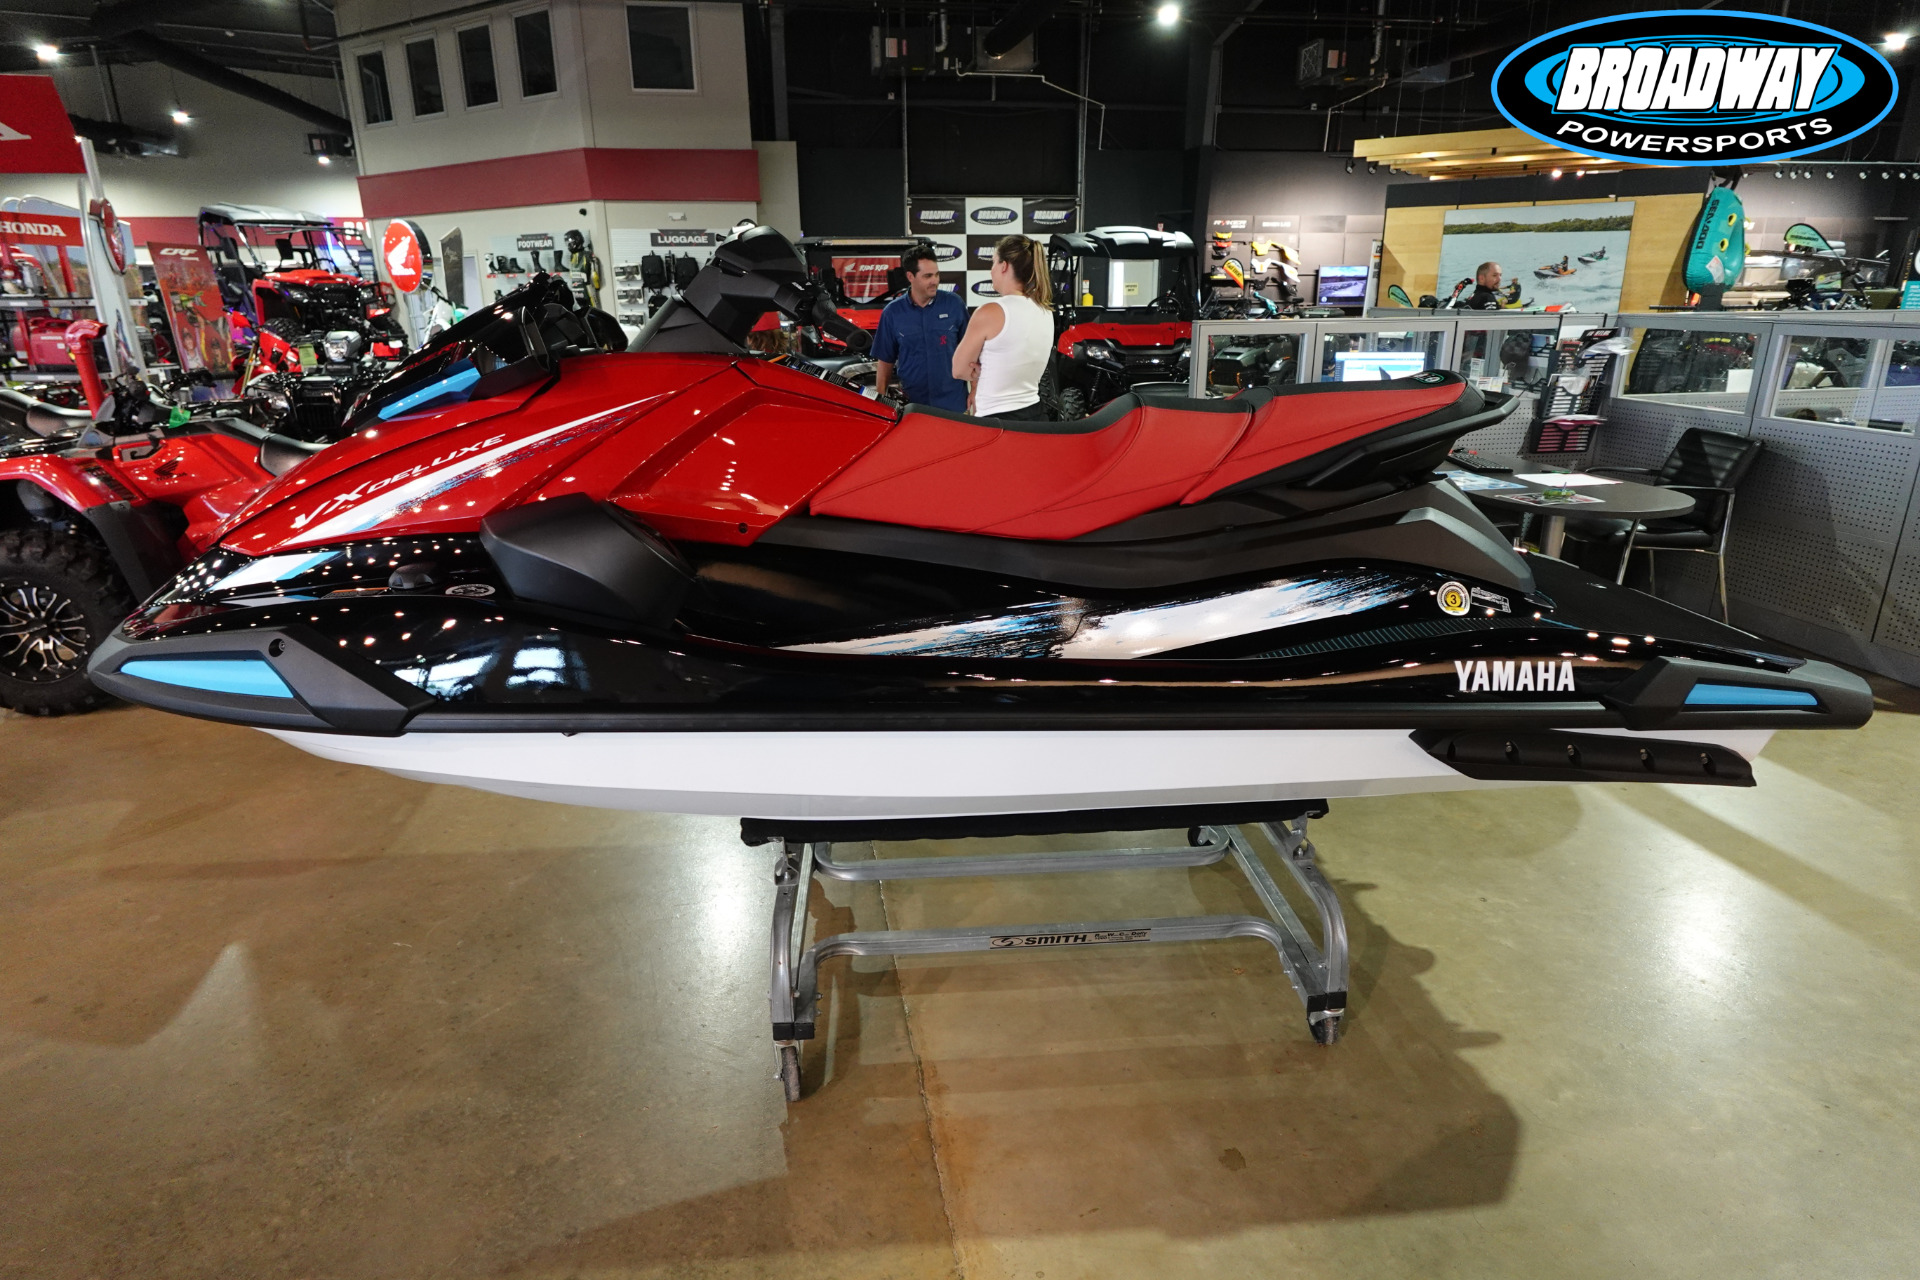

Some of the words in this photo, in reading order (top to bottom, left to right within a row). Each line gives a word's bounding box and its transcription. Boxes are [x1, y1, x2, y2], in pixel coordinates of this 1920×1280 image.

[920, 210, 955, 220] BROADWAY
[977, 210, 1012, 220] BROADWAY
[1033, 210, 1067, 220] BROADWAY
[0, 221, 66, 237] HONDA
[518, 239, 553, 249] FOOTWEAR
[657, 235, 709, 244] LUGGAGE
[367, 433, 506, 494] DELUXE
[1450, 594, 1458, 605] 3
[1454, 660, 1576, 692] YAMAHA
[1024, 934, 1088, 945] SMITH
